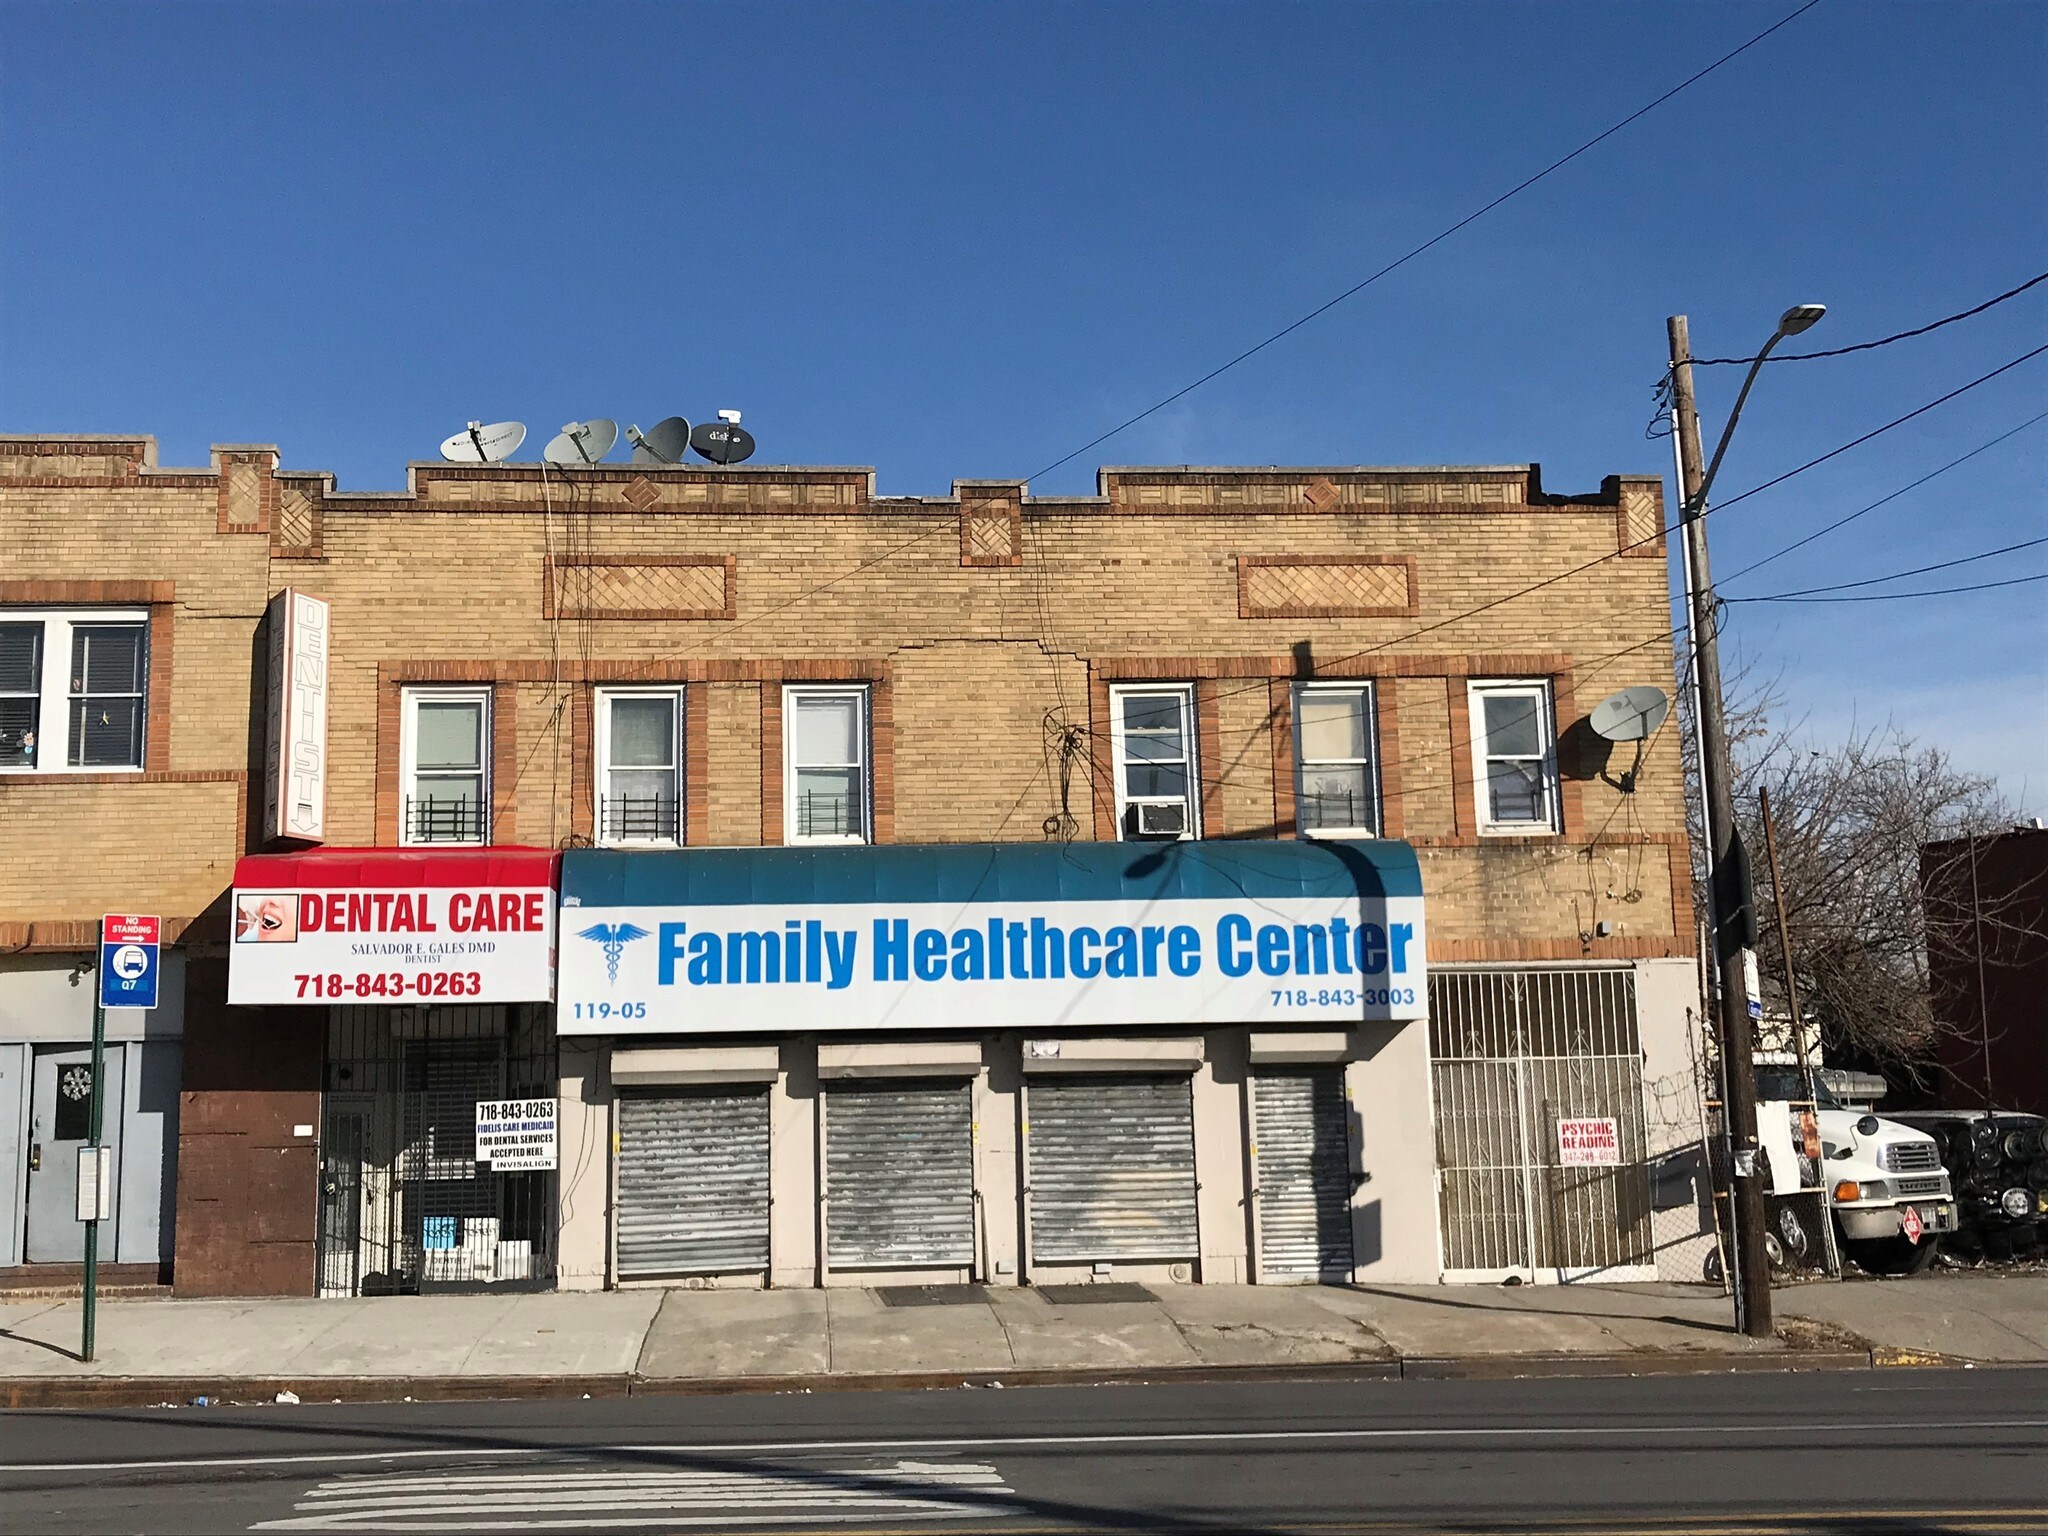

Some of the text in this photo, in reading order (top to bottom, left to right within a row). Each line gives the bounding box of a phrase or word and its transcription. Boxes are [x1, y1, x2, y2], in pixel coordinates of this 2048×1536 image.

[294, 596, 324, 801] DENTIST
[299, 893, 544, 932] DENTAL CARE
[125, 917, 139, 925] NO
[112, 925, 152, 934] STANDING
[351, 941, 496, 955] SALVADOR E. GALES DMD
[658, 913, 1413, 989] Family Healthcare Center
[405, 955, 442, 964] DENTIST
[121, 980, 137, 990] Q7
[294, 972, 481, 998] 718-843-0263
[1271, 988, 1415, 1007] 718-843-3003
[574, 1002, 647, 1019] 119-05
[480, 1101, 553, 1121] 718-843-0263
[477, 1121, 554, 1134] FIDELIS CARE MEDICAID
[1561, 1122, 1613, 1135] PSYCHIC
[480, 1134, 553, 1146] FOR DENTAL SERVICES
[1562, 1136, 1615, 1149] READING
[490, 1147, 543, 1158] ACCEPTED HERE
[496, 1160, 552, 1168] INVISALIGN
